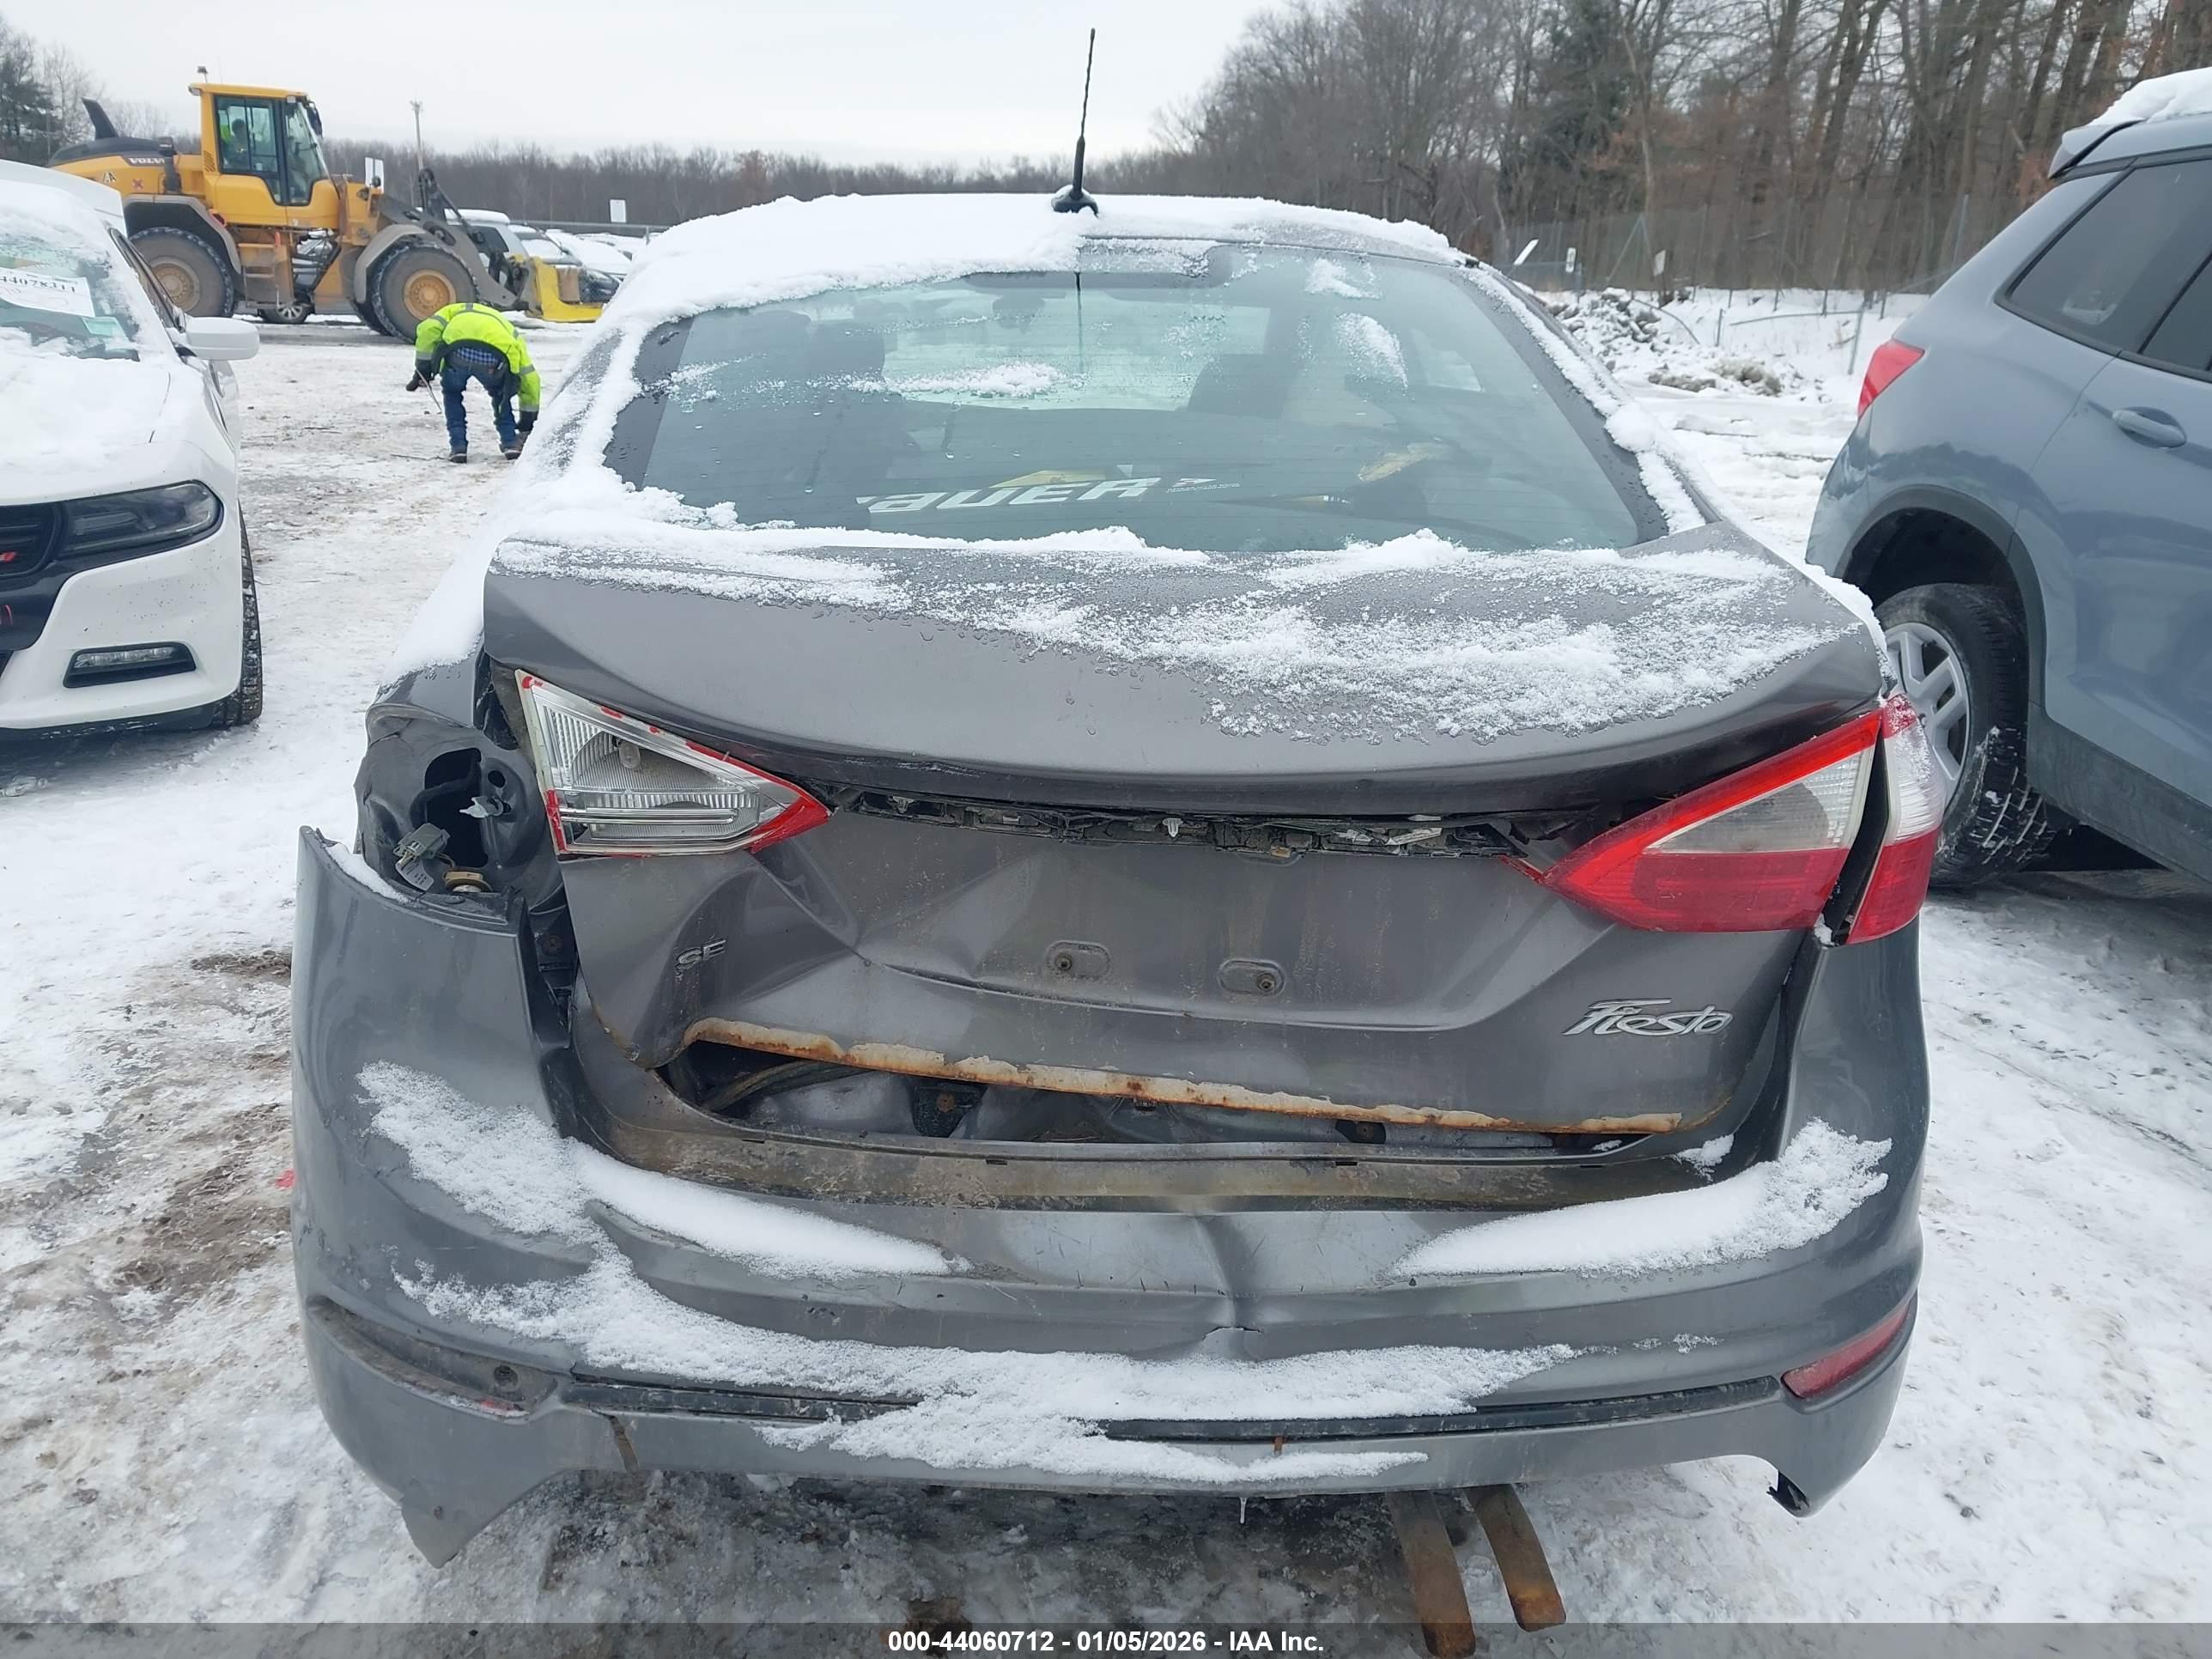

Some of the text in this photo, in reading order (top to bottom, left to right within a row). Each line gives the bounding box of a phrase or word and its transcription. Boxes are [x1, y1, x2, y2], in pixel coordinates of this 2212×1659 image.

[856, 477, 1161, 514] AUER
[677, 939, 726, 971] SE
[1561, 998, 1733, 1036] Fiesta
